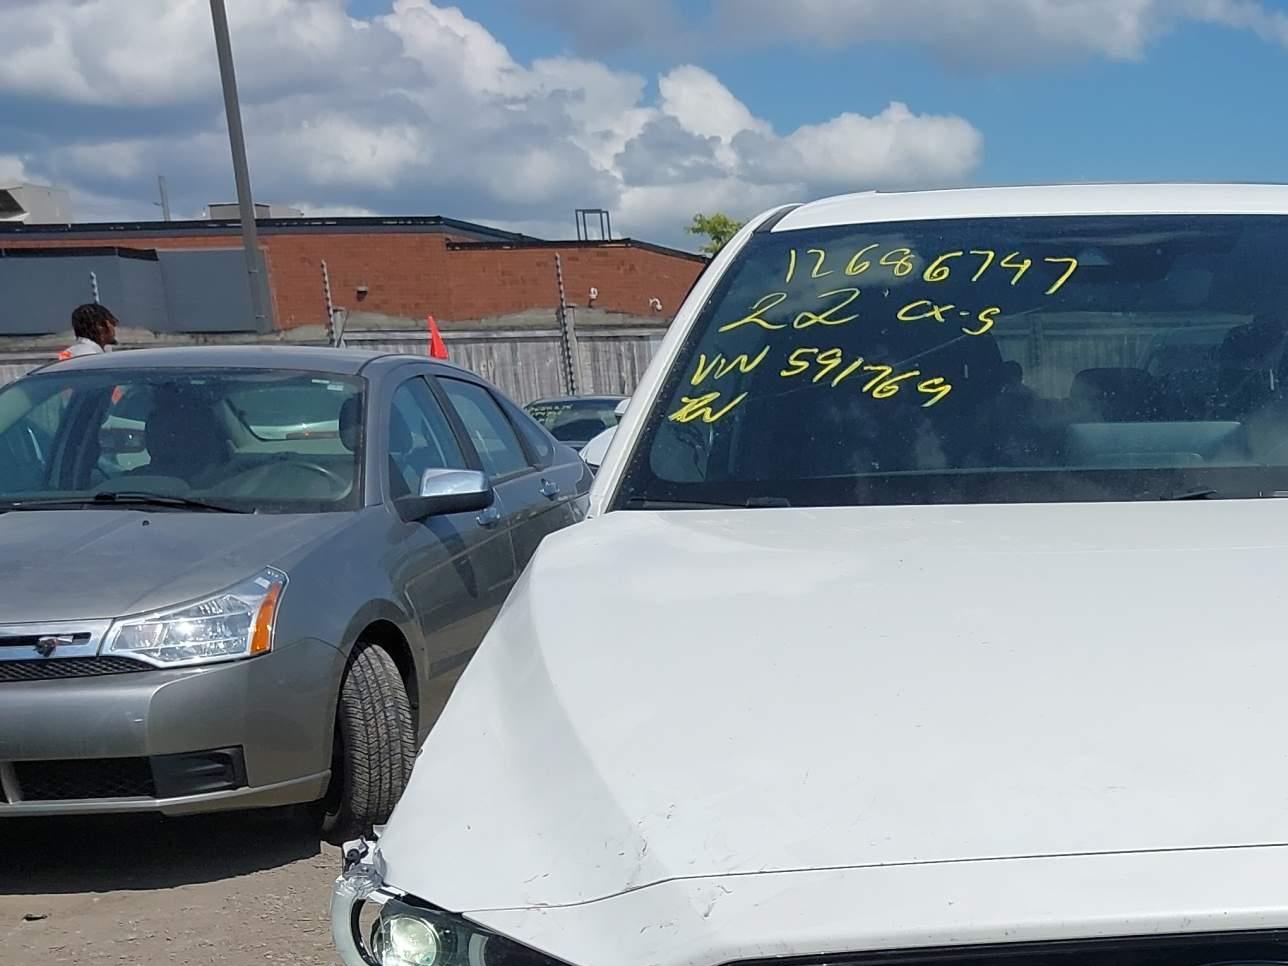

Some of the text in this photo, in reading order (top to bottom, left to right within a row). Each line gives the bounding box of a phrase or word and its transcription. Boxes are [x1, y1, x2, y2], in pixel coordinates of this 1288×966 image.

[786, 243, 1078, 294] 12686747
[718, 288, 861, 332] 22
[780, 347, 952, 408] 591769
